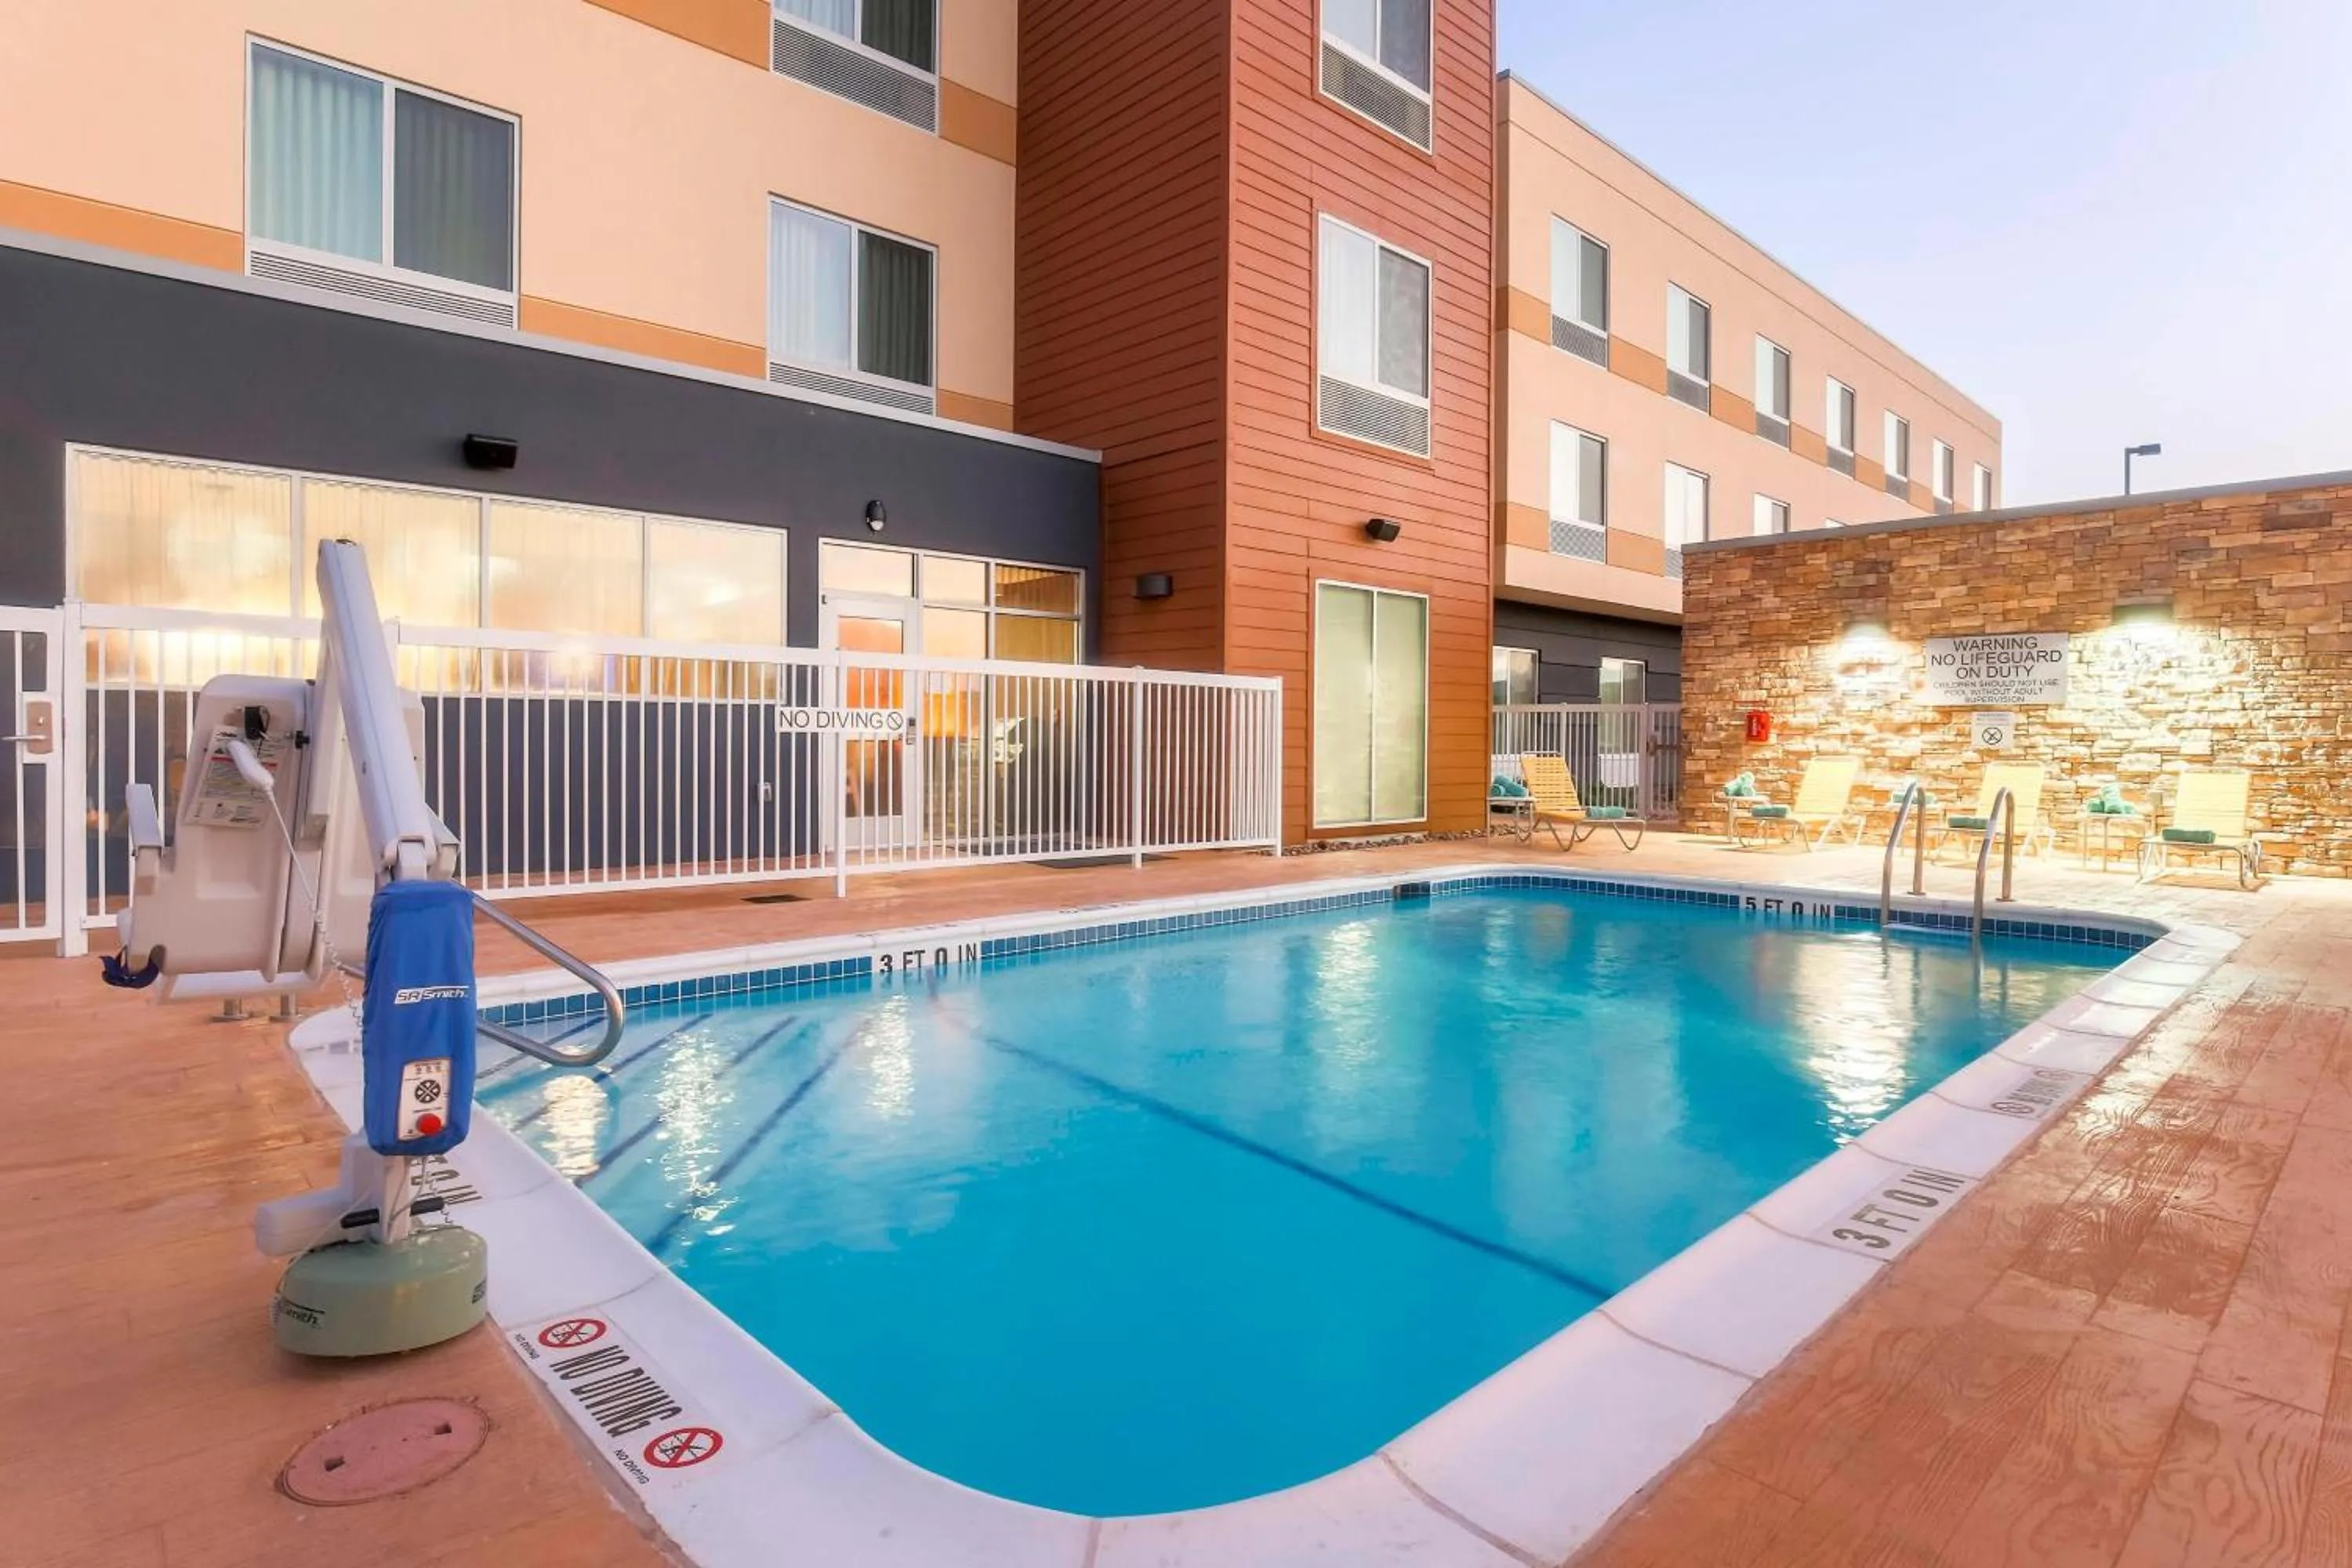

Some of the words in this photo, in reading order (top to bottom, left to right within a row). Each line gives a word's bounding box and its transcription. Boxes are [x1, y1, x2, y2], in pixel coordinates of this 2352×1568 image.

[1953, 636, 2038, 652] WARNING
[1931, 653, 1956, 666] NO
[1960, 650, 2063, 666] LIFEGUARD
[1956, 666, 1981, 680] ON
[1986, 665, 2034, 678] DUTY
[779, 710, 810, 728] NO
[816, 710, 883, 729] DIVING
[1744, 896, 1756, 910] 5
[1765, 898, 1784, 913] FT
[1813, 902, 1831, 917] IN
[880, 953, 893, 974] 3
[902, 949, 926, 971] FT
[958, 942, 977, 963] IN
[1900, 1168, 1965, 1193] IN
[1849, 1203, 1920, 1233] FT
[1831, 1228, 1891, 1249] 3
[549, 1345, 630, 1380] NO
[570, 1367, 683, 1438] DIVING
[614, 1449, 629, 1461] NO
